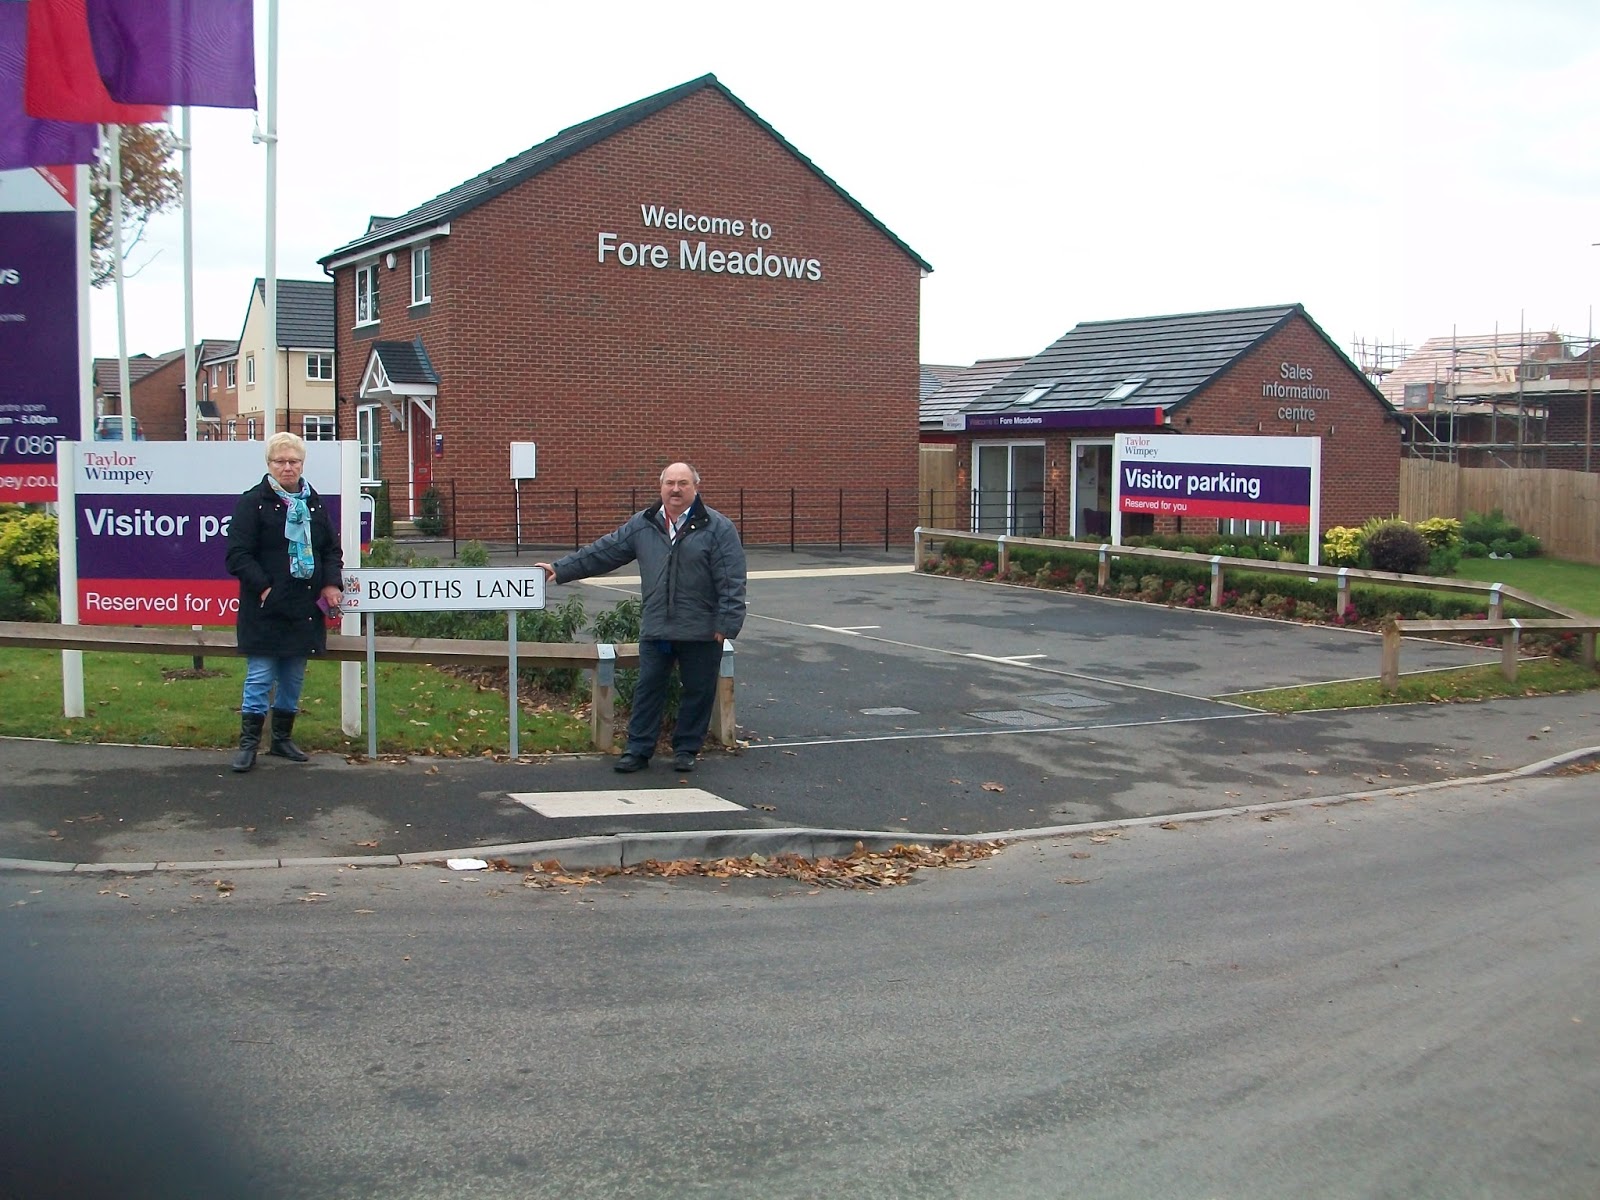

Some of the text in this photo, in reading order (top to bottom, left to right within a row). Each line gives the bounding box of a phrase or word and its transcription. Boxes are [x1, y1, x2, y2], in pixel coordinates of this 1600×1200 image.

[641, 204, 772, 240] Welcome to
[598, 232, 822, 281] Fore Meadows
[1280, 362, 1313, 380] Sales
[1262, 380, 1330, 400] information
[22, 404, 47, 413] open
[1278, 405, 1316, 421] centre
[1000, 417, 1013, 425] Fore
[1014, 416, 1042, 425] Meadows
[15, 435, 66, 455] 086
[1125, 436, 1151, 446] Taylor
[84, 451, 136, 470] Taylor
[1125, 446, 1158, 458] Wimpey
[84, 467, 154, 485] Wimpey
[1125, 468, 1261, 499] Visitor parking
[1125, 498, 1188, 512] Reserved for you
[84, 509, 190, 537] Visitor
[368, 579, 535, 600] BOOTHS LANE
[86, 592, 178, 611] Reserved
[184, 593, 212, 612] for
[347, 599, 359, 607] 42
